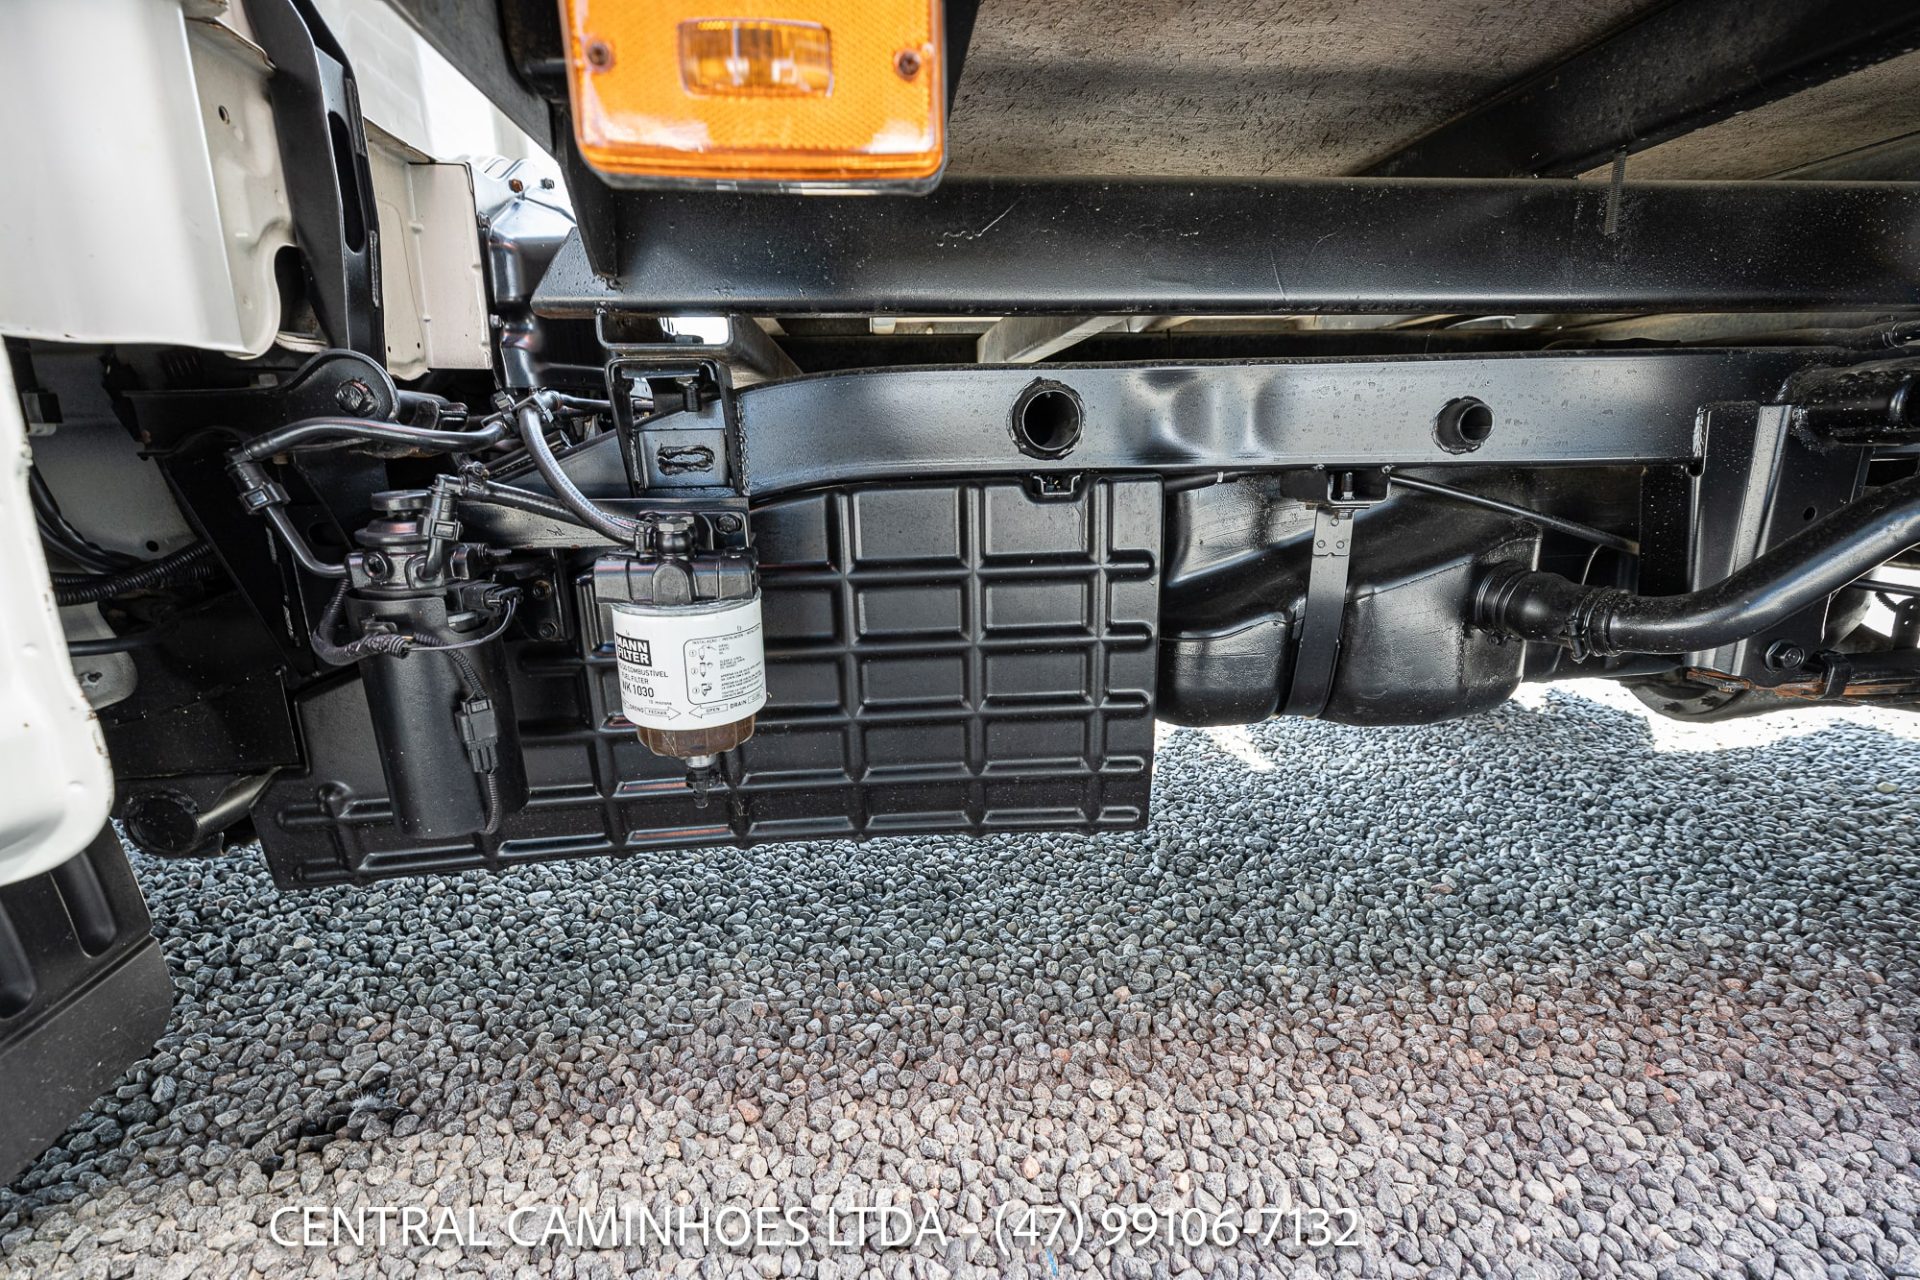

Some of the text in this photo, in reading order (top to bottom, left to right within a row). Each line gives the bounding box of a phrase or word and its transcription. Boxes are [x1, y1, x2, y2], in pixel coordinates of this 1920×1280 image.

[616, 635, 648, 653] MANN
[617, 644, 650, 664] FILTER
[633, 684, 655, 698] 1030
